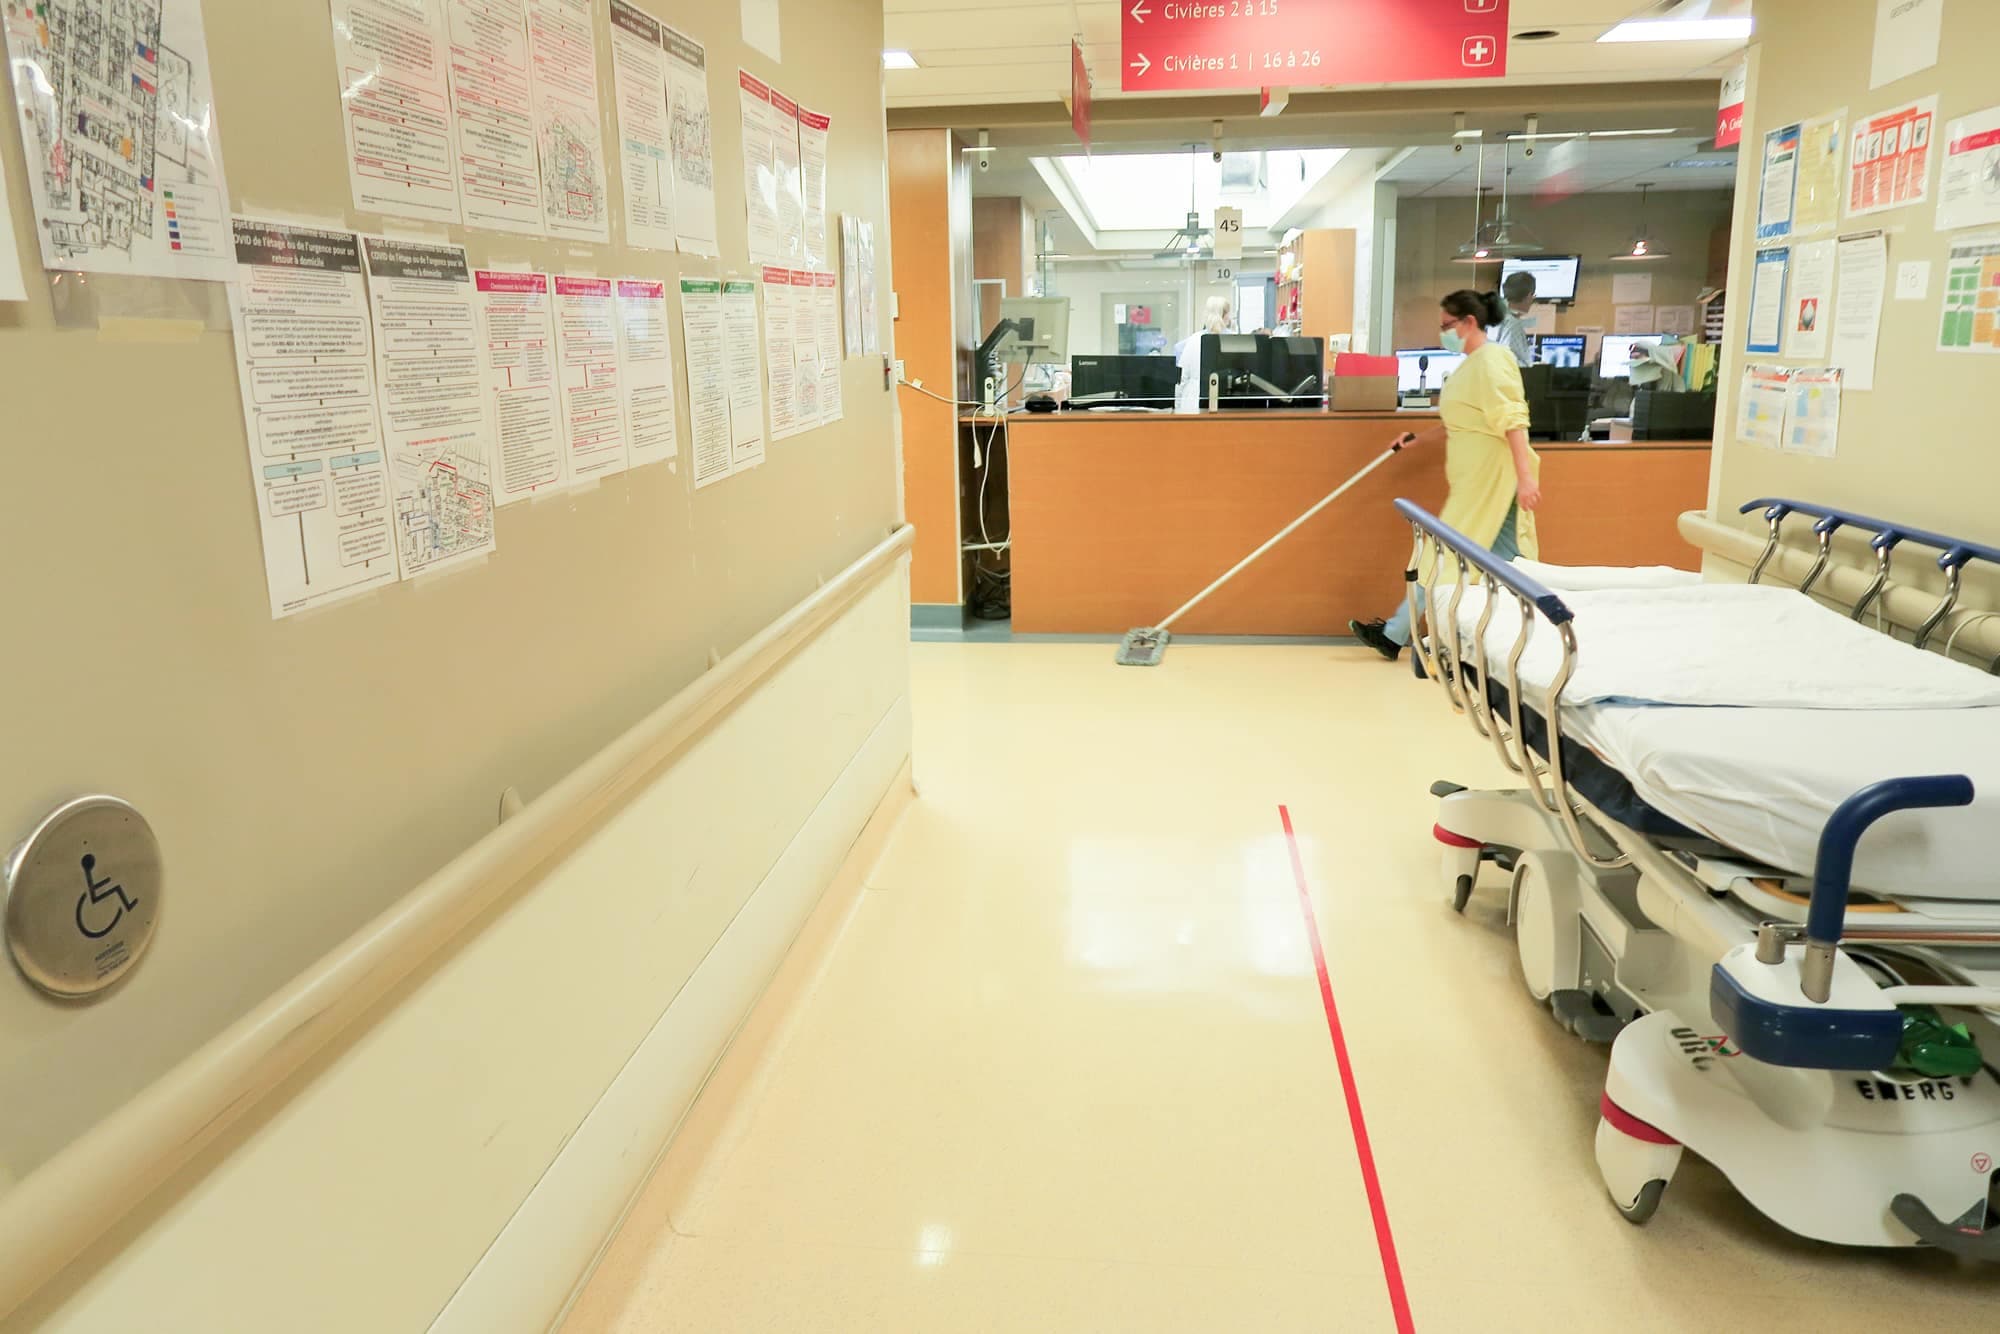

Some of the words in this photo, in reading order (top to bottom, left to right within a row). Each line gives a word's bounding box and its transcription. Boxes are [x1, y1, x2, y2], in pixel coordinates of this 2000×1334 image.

[1164, 1, 1225, 20] Civières
[1230, 1, 1239, 16] 2
[1259, 0, 1277, 16] 15
[1163, 52, 1224, 72] Civières
[1229, 55, 1238, 70] 1
[1263, 52, 1282, 69] 16
[1287, 51, 1296, 68] à
[1301, 50, 1321, 67] 26
[1219, 218, 1239, 233] 45
[234, 234, 251, 245] OVID
[1217, 268, 1231, 279] 10
[1855, 1079, 1954, 1101] EERG
